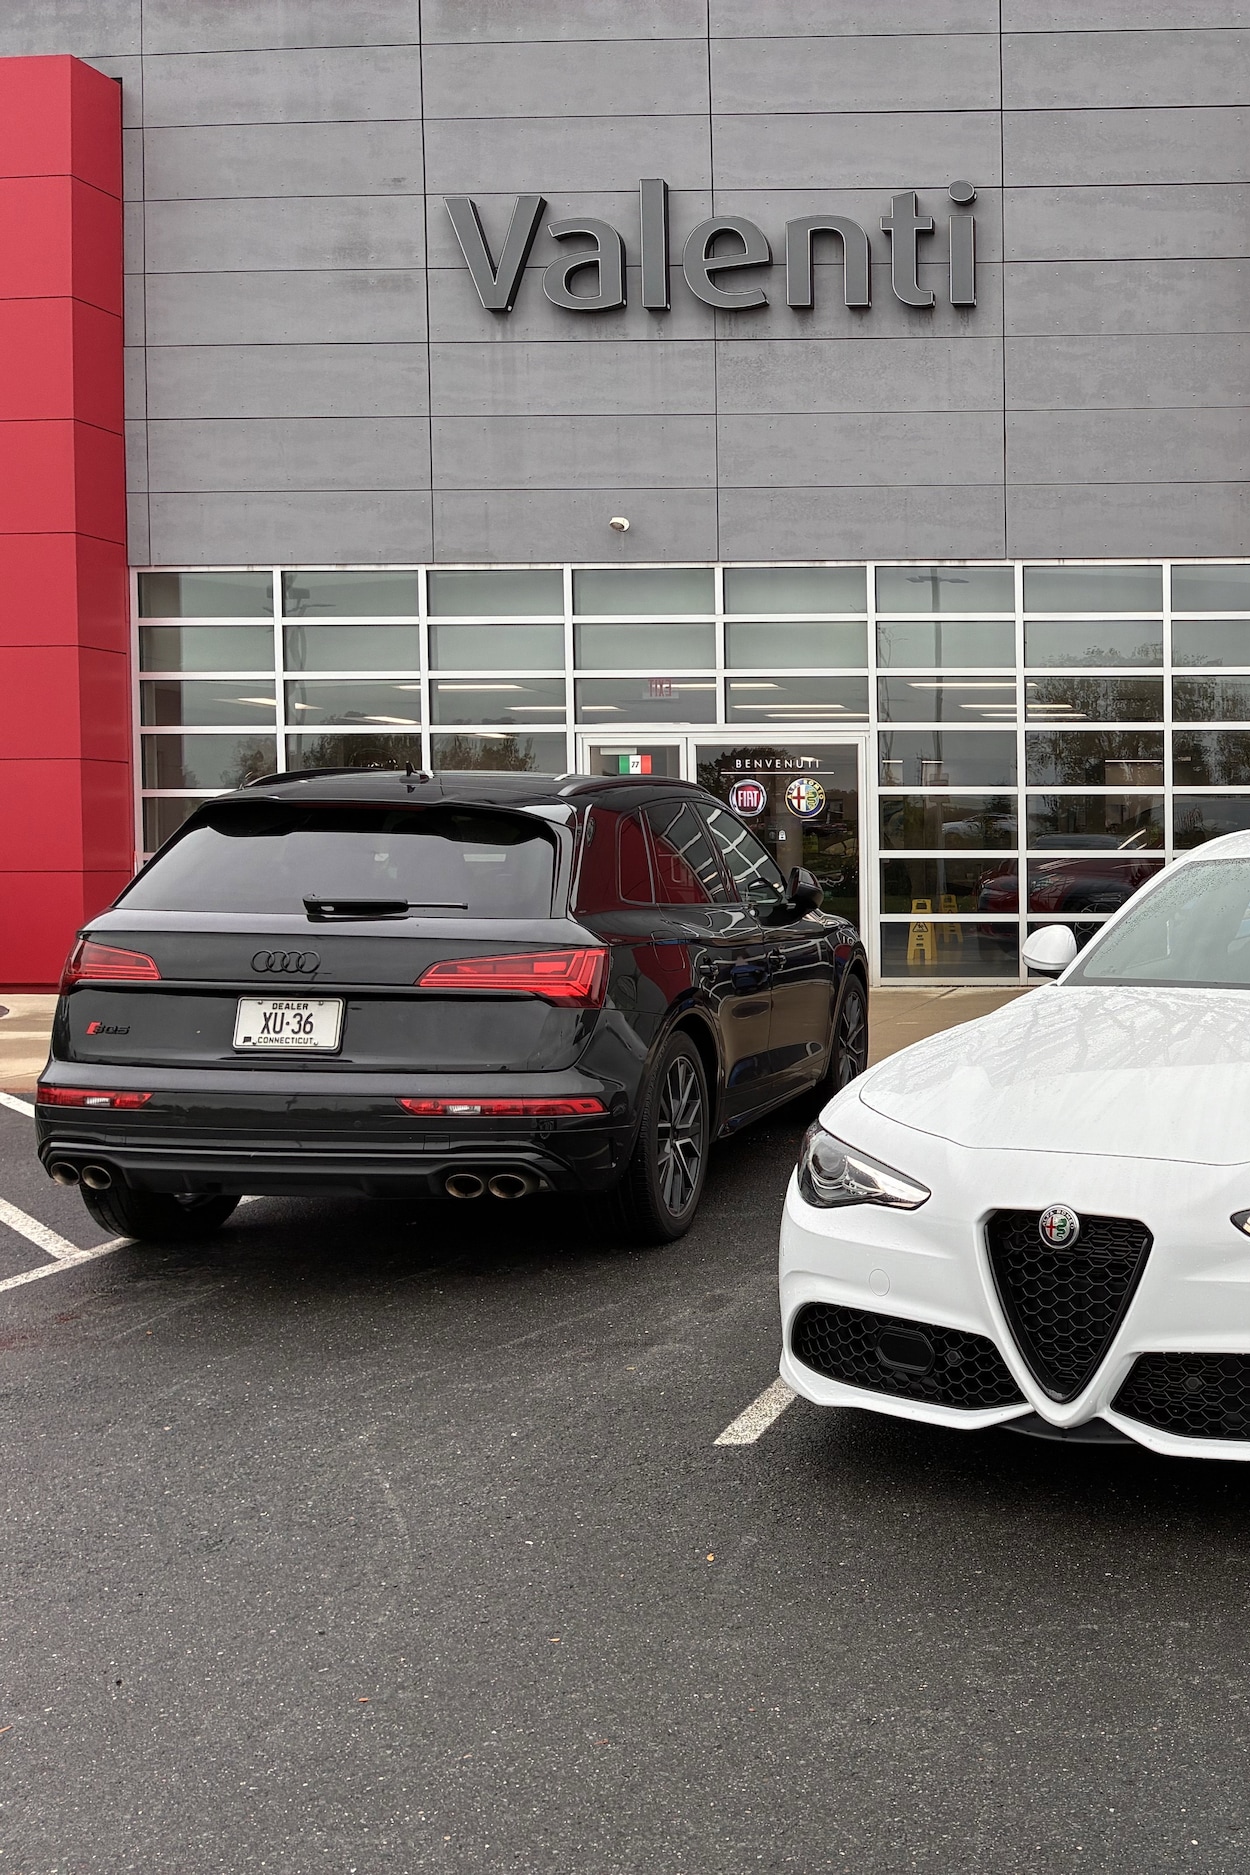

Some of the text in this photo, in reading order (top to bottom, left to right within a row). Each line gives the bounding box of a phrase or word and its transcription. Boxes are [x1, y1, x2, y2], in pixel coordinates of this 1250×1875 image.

[443, 178, 977, 313] Valenti
[735, 759, 820, 769] BENVENUTI
[738, 790, 760, 808] FIAT
[272, 1002, 309, 1011] DEALER
[257, 1036, 314, 1045] CONNECTICUT
